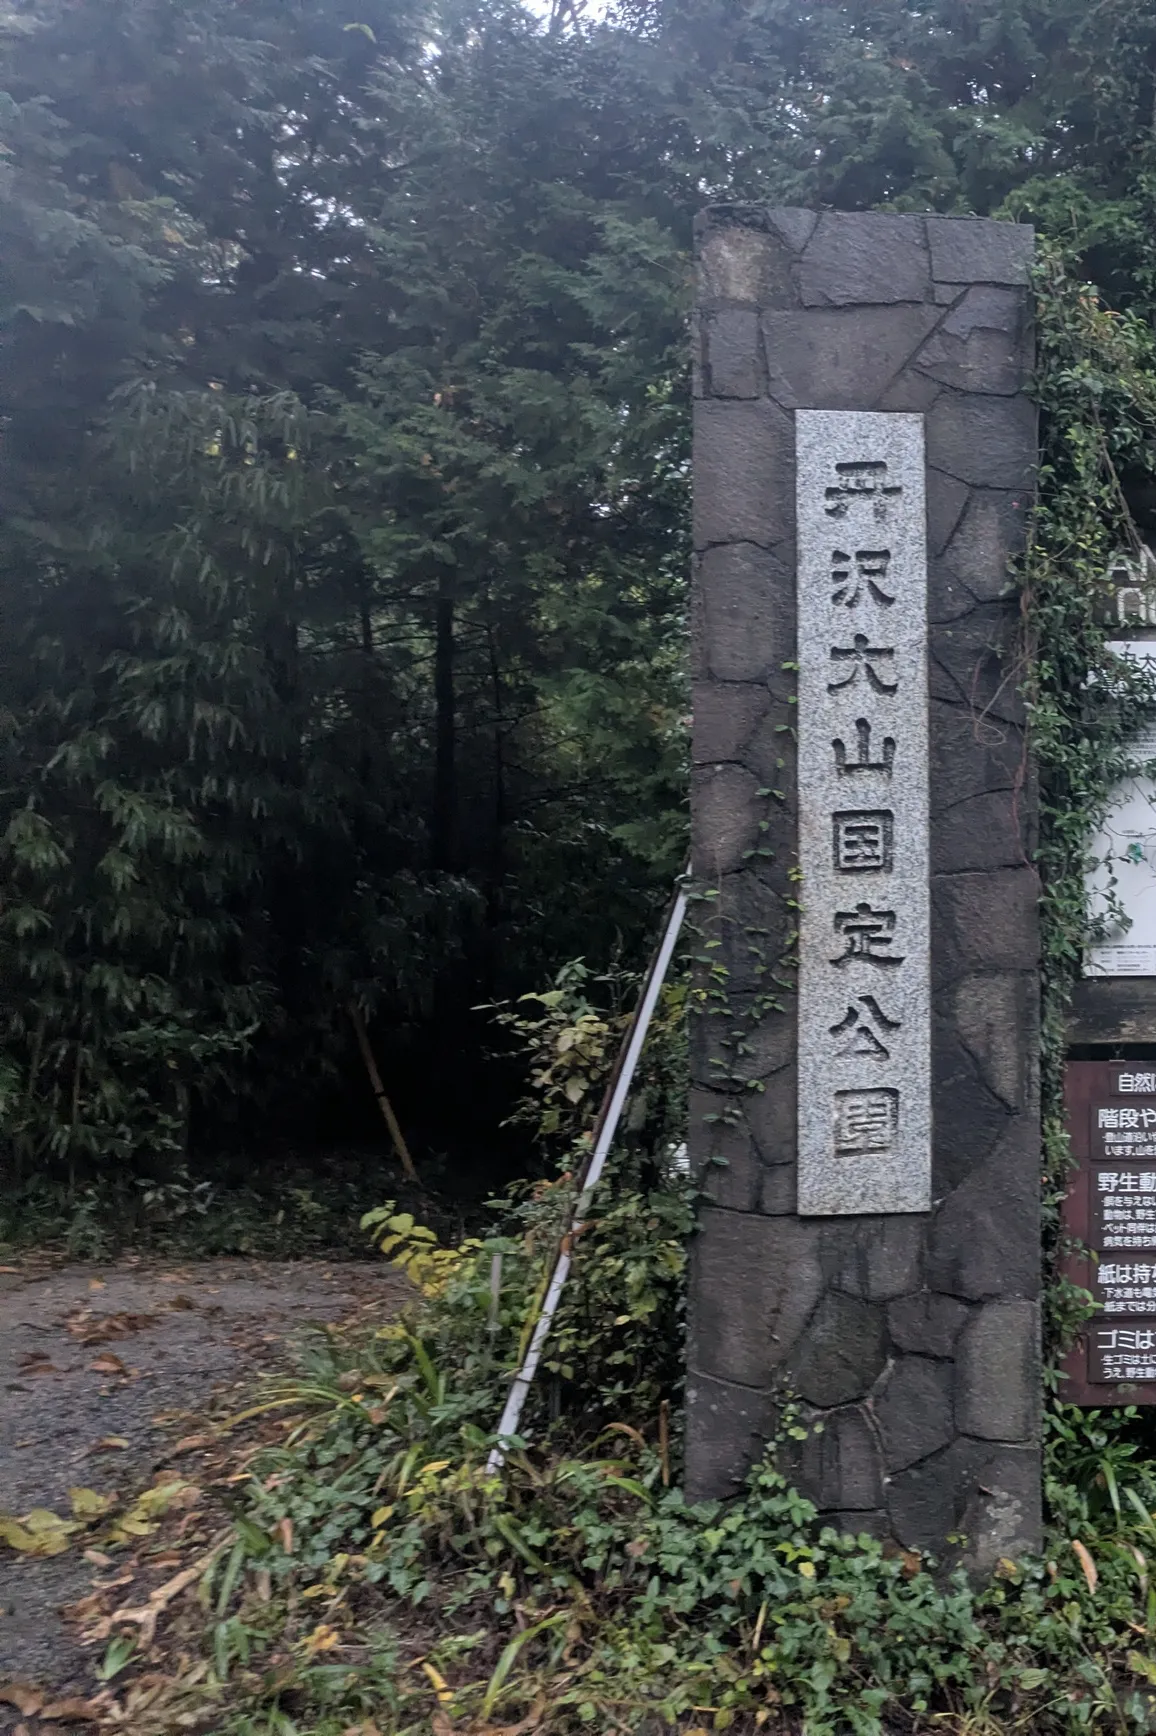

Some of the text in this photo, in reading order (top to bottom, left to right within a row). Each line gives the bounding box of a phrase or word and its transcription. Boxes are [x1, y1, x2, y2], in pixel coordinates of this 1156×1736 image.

[825, 460, 905, 1158] 丹沢大山国定公園
